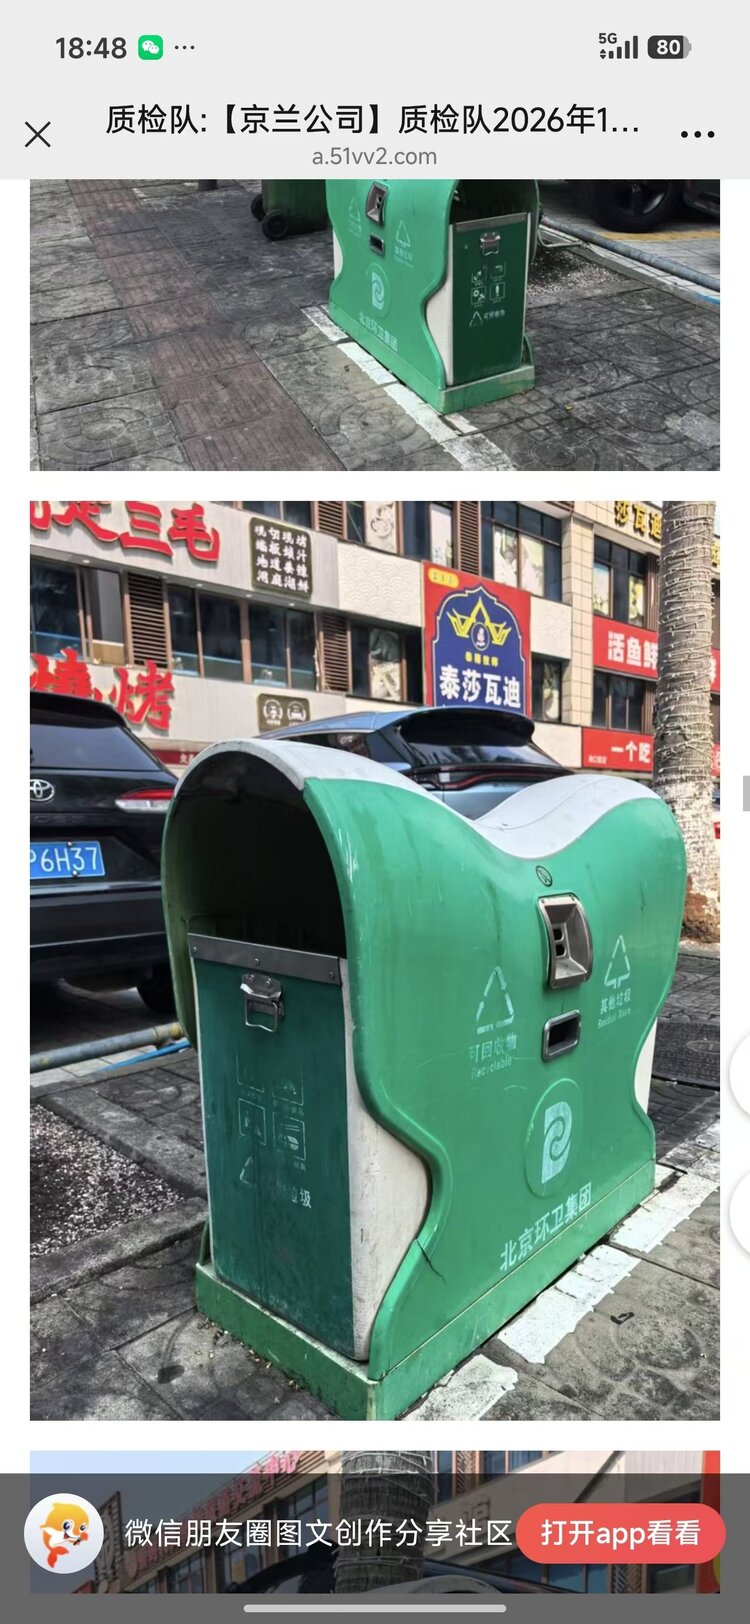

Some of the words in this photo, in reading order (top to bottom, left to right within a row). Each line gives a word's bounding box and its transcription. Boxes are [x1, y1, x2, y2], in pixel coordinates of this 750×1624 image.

[55, 36, 127, 60] 18:48
[597, 32, 618, 44] 5G
[656, 39, 681, 55] 80
[312, 148, 437, 166] a.51vv2.com
[439, 664, 521, 708] 泰莎瓦迪
[611, 740, 651, 763] 一个吃
[600, 987, 632, 1015] 其他垃圾
[500, 1181, 592, 1271] 北京环卫集团
